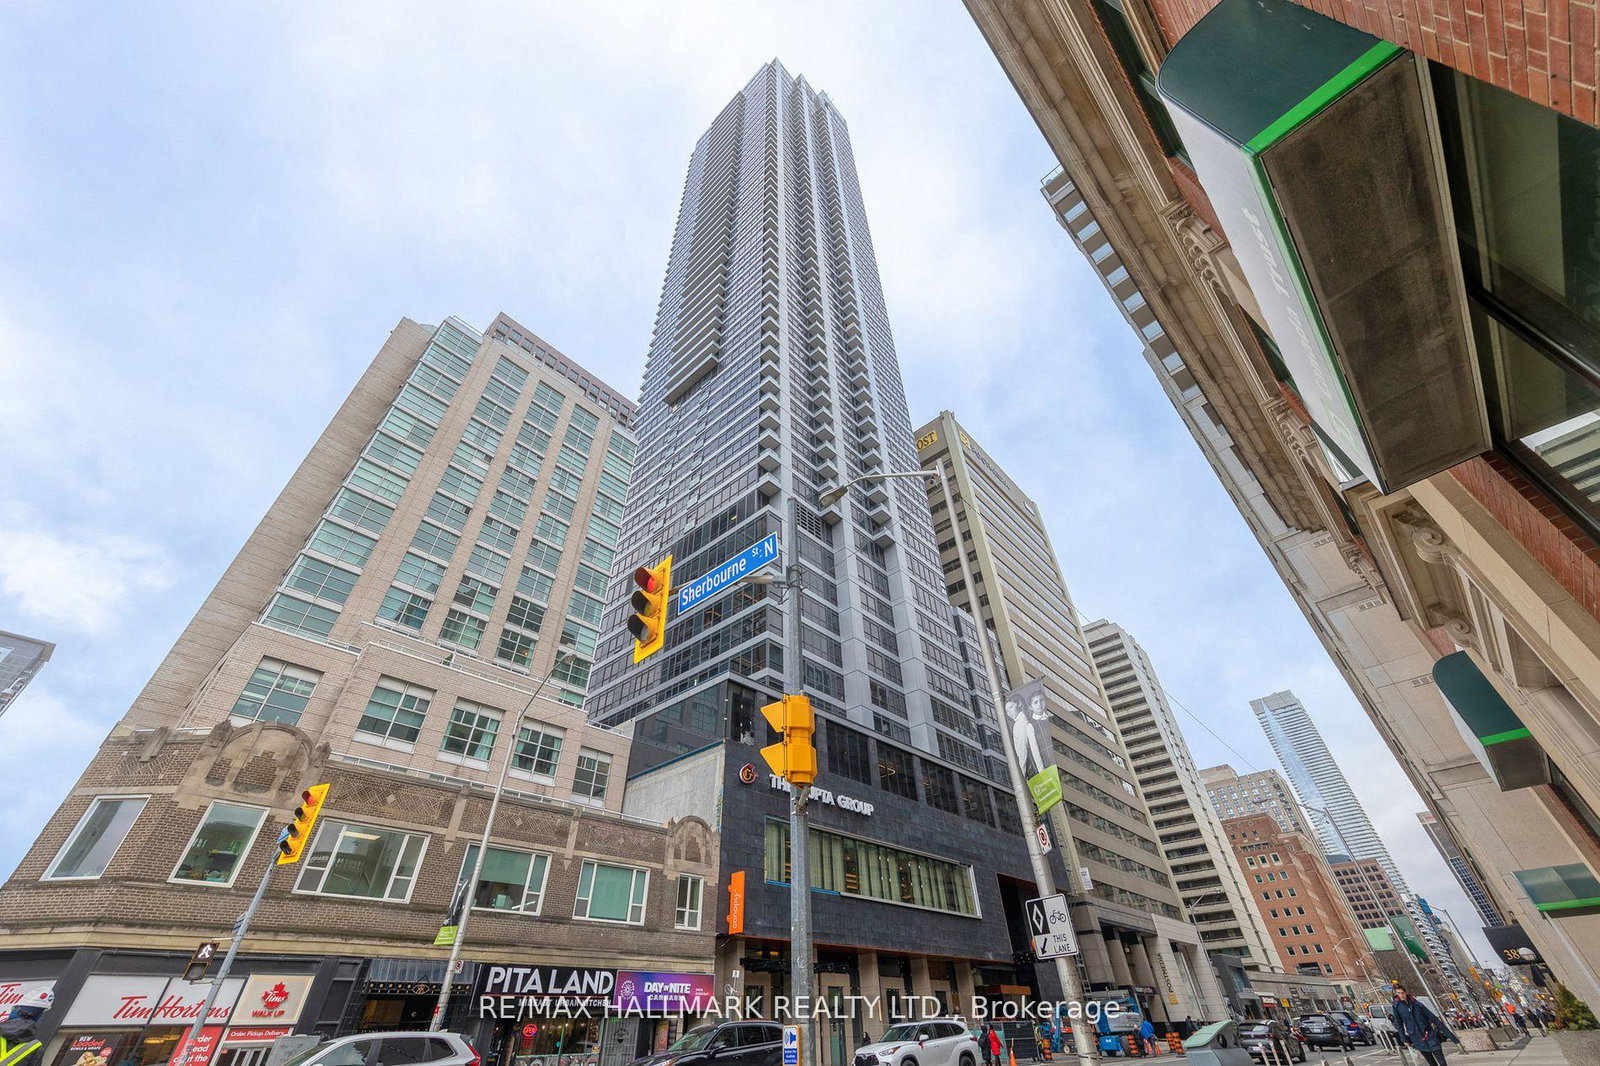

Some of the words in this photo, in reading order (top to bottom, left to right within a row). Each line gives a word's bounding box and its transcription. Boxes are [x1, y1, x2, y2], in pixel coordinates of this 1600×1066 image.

[916, 432, 935, 450] OST
[682, 558, 747, 606] Sherbourne
[764, 538, 774, 557] N
[808, 786, 836, 806] UPTA
[837, 795, 875, 816] GROUP
[1053, 933, 1067, 943] THIS
[1054, 943, 1071, 954] LANE
[1157, 952, 1174, 993] POSTMEDIA
[485, 966, 543, 994] PITA
[548, 969, 614, 995] LAND
[644, 981, 663, 993] DAY
[669, 983, 691, 994] NITE
[265, 991, 286, 1003] Tims
[113, 995, 153, 1019] Tim
[151, 994, 232, 1019] Hortns
[251, 1010, 271, 1018] WALK
[274, 1010, 285, 1018] UP
[72, 1039, 106, 1048] Loaded
[194, 1054, 208, 1062] the
